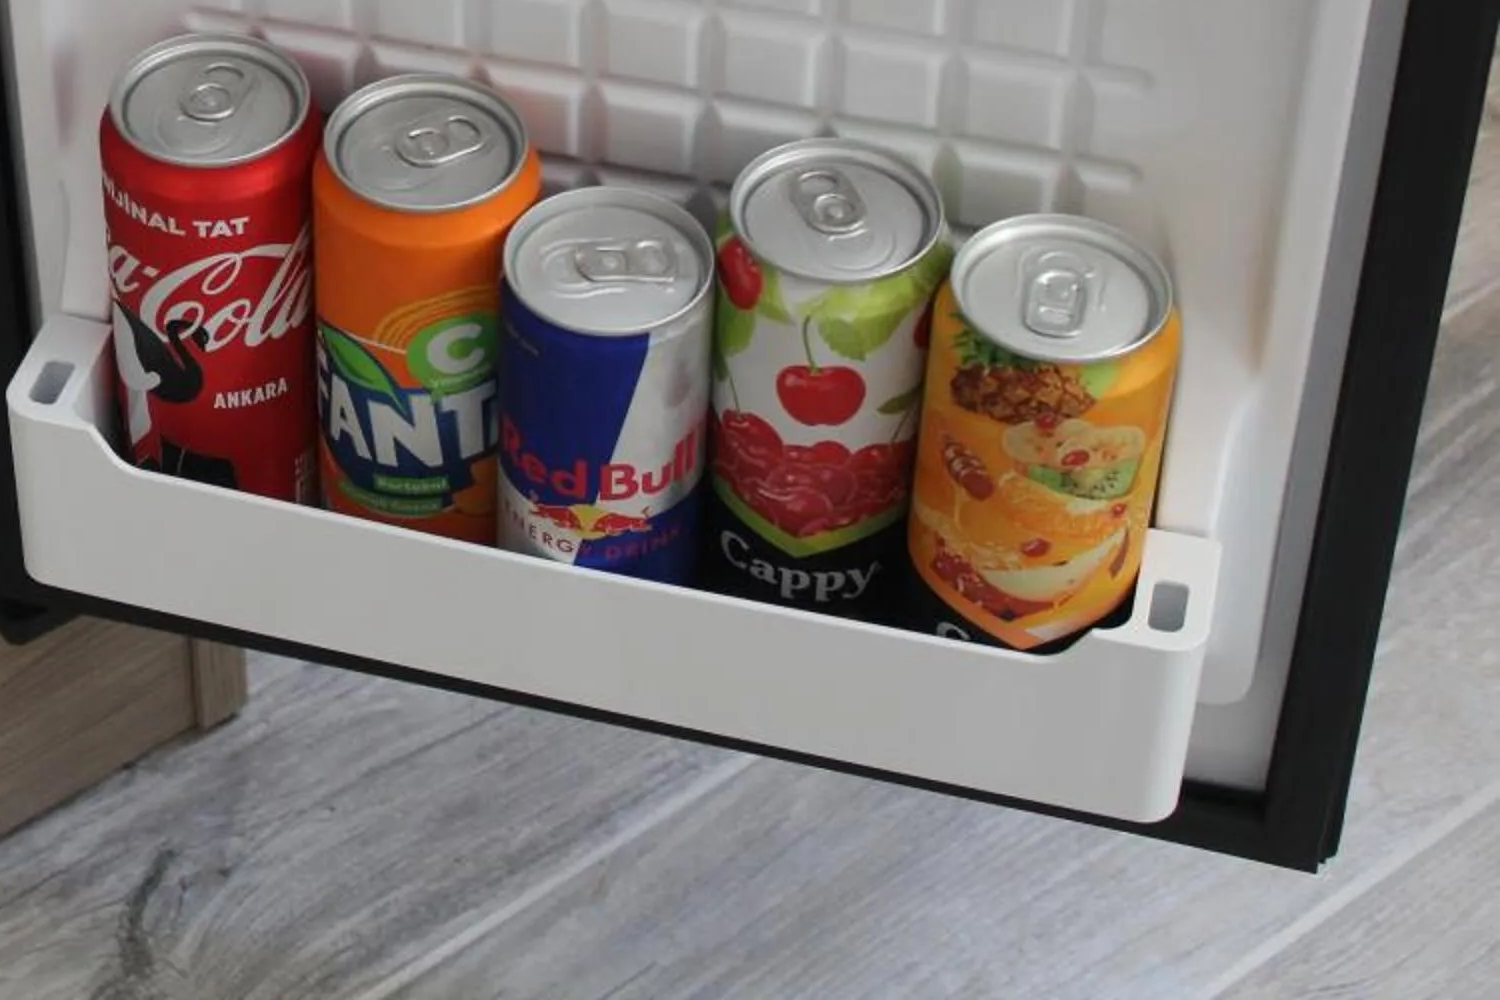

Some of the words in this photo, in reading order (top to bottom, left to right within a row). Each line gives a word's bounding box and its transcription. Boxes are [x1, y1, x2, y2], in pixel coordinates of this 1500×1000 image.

[193, 216, 251, 238] TAT
[213, 378, 289, 410] ANKARA
[502, 416, 588, 500] Red
[598, 428, 699, 501] Bull
[719, 528, 880, 602] Cappy
